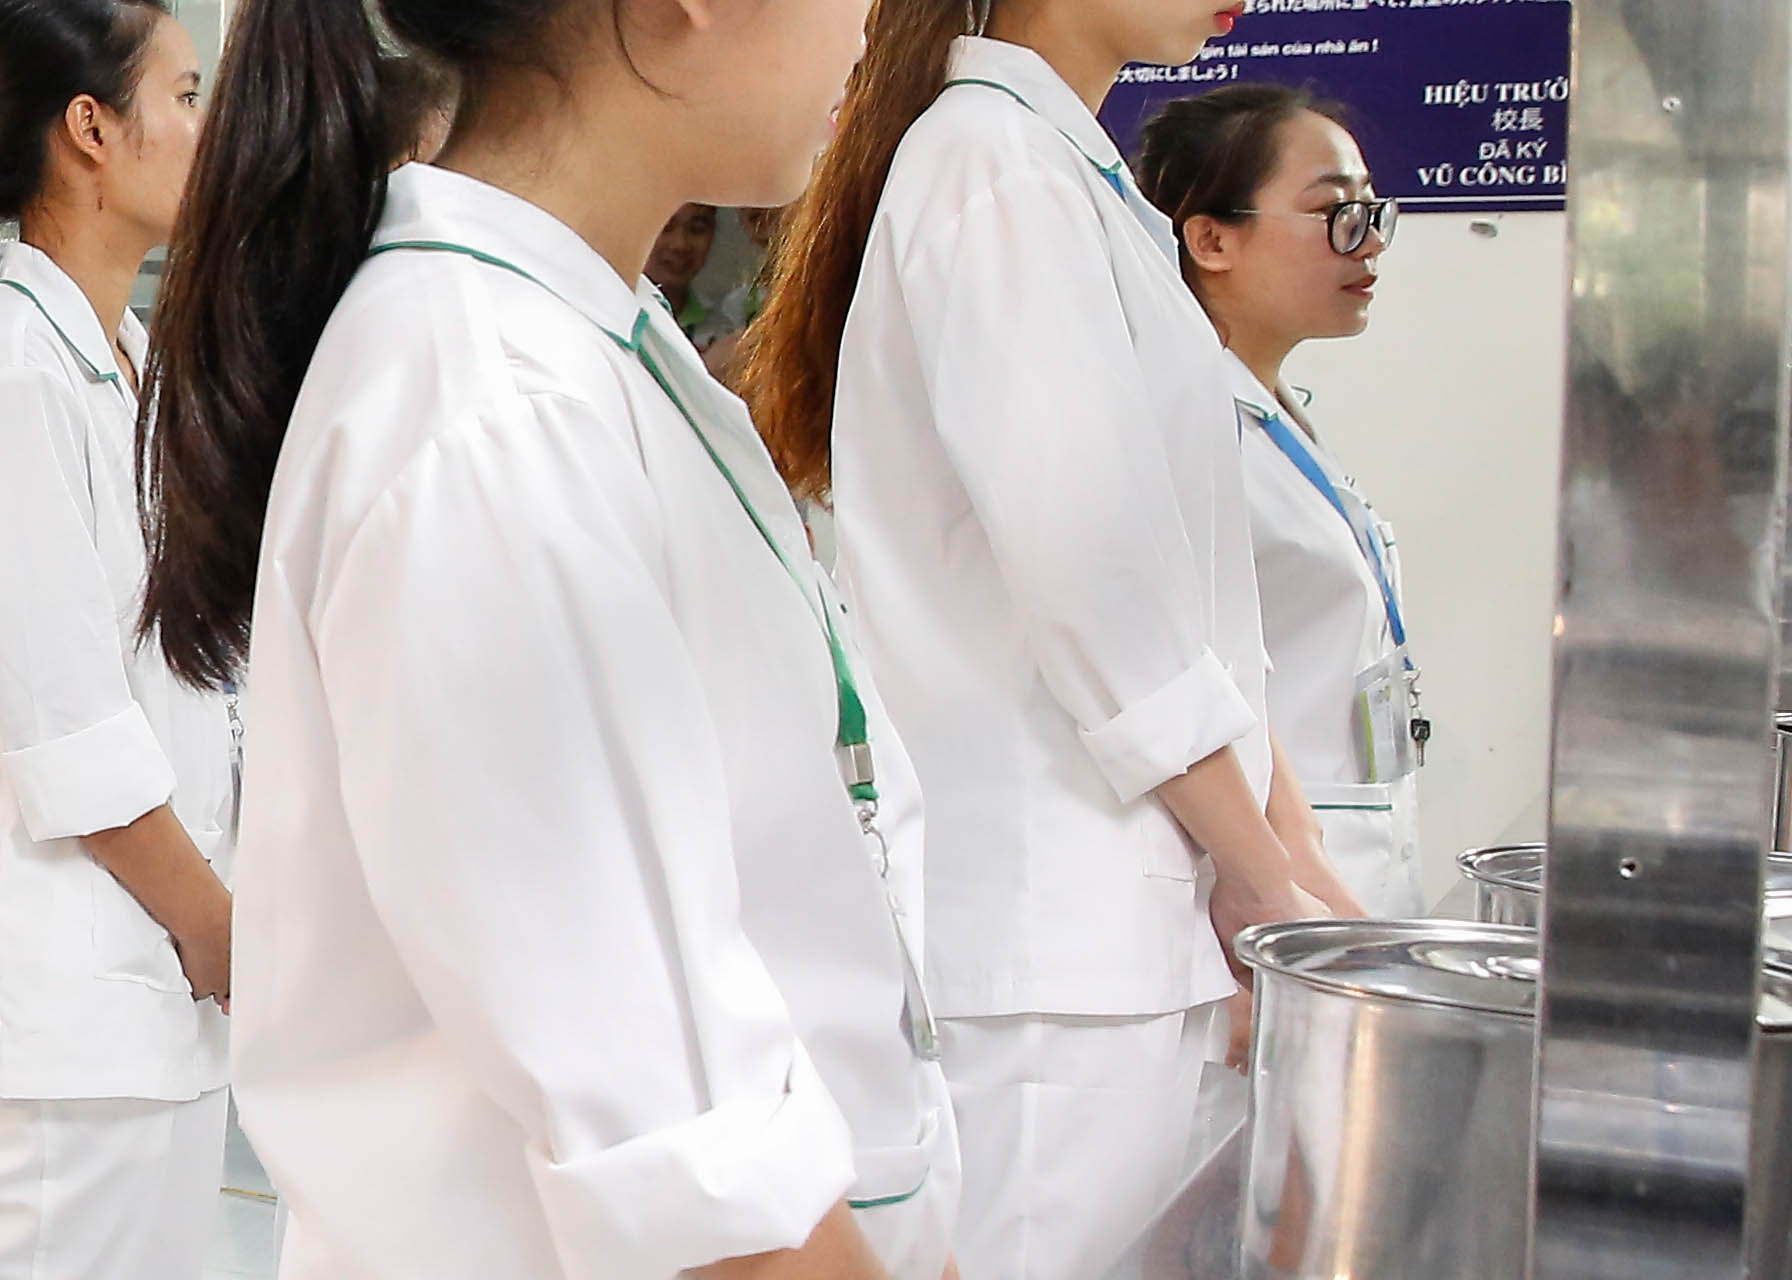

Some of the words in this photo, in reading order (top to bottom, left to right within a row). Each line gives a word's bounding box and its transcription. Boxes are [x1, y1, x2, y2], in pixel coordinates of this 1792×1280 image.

[1423, 79, 1489, 108] HIỆU
[1491, 107, 1544, 132] 校長
[1478, 138, 1512, 161] ĐÃ
[1516, 137, 1548, 160] KÝ
[1417, 162, 1454, 187] VŨ
[1459, 161, 1536, 186] CÔNG
